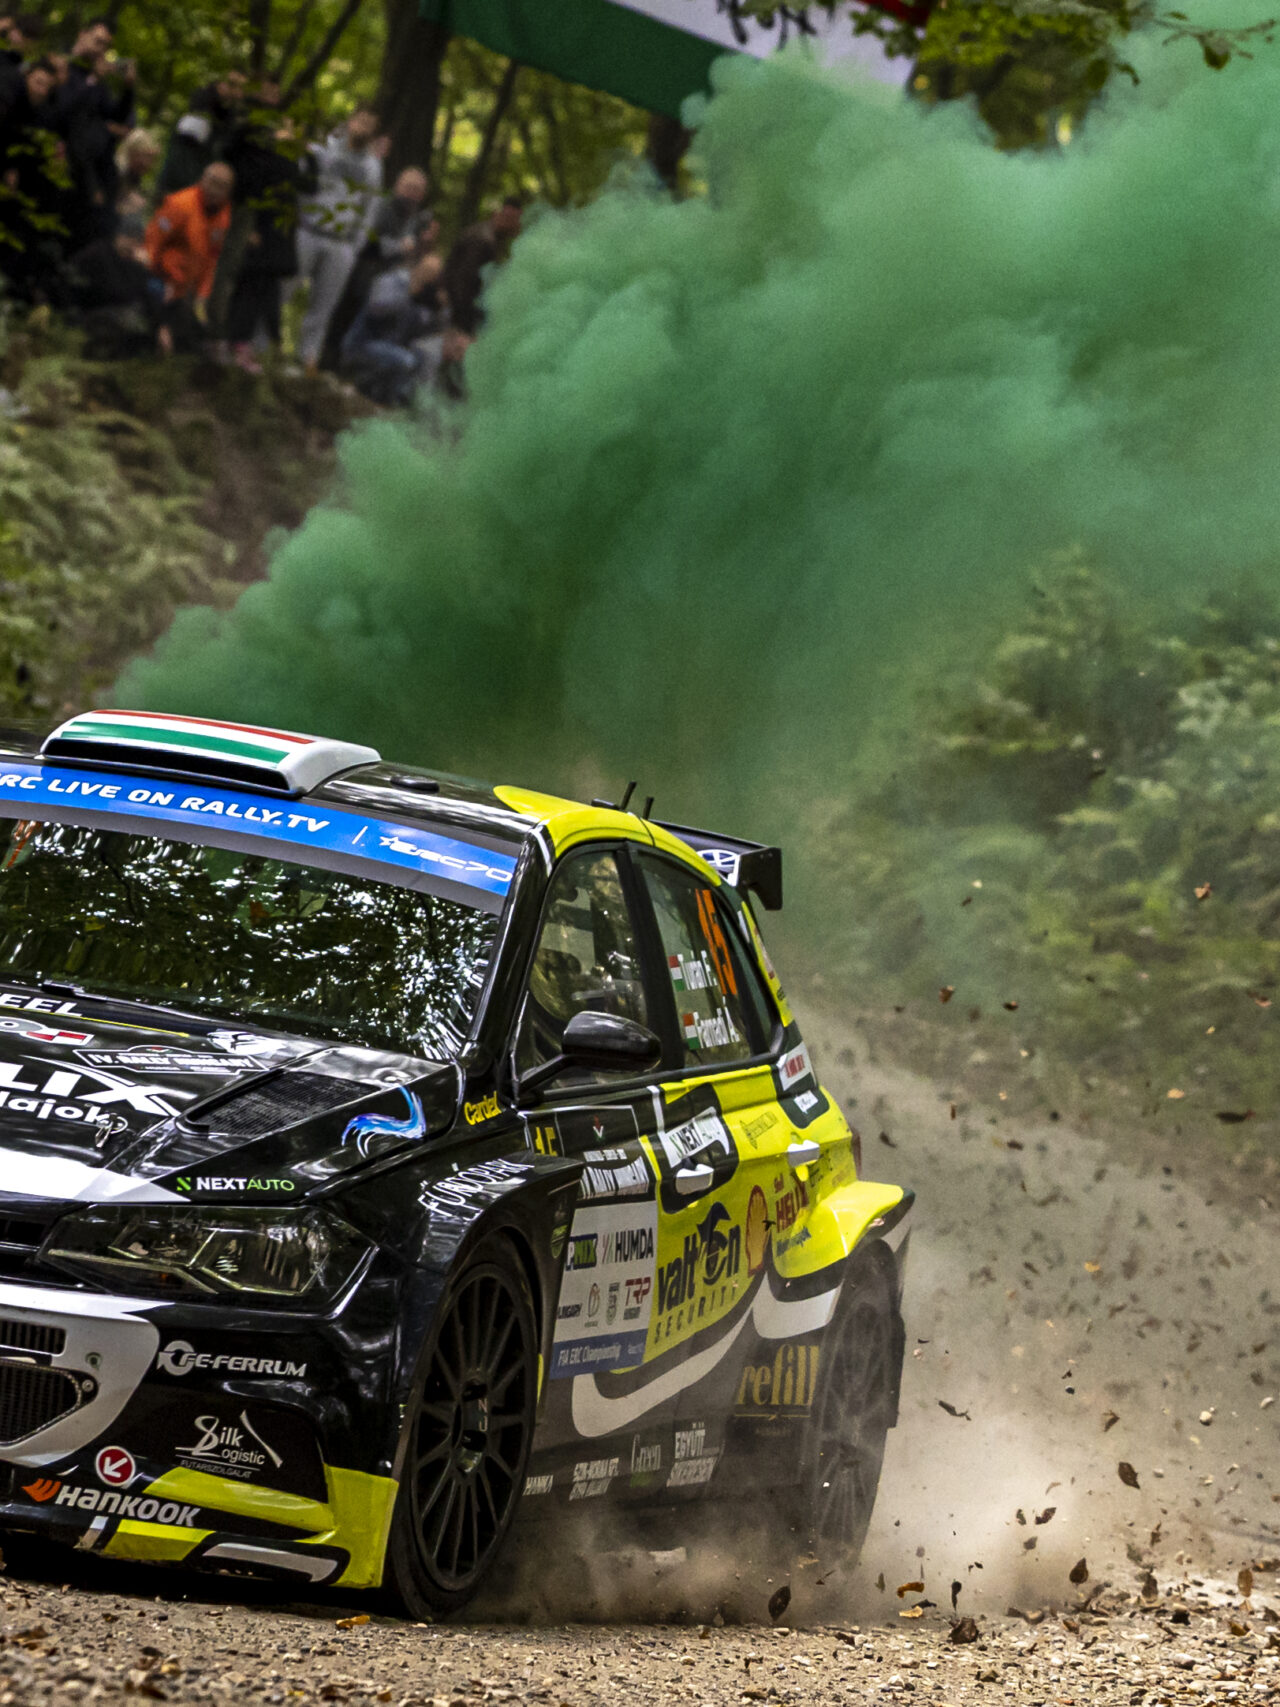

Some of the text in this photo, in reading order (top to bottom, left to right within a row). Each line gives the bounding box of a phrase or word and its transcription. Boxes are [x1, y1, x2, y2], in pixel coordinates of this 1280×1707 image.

[48, 779, 122, 798] LIVE
[128, 789, 175, 806] ON
[180, 797, 330, 833] RALLY.TV
[197, 1177, 295, 1192] NEXTAUTO
[614, 1227, 654, 1263] HUMDA
[735, 1343, 820, 1406] refill
[194, 1415, 245, 1451] Silk
